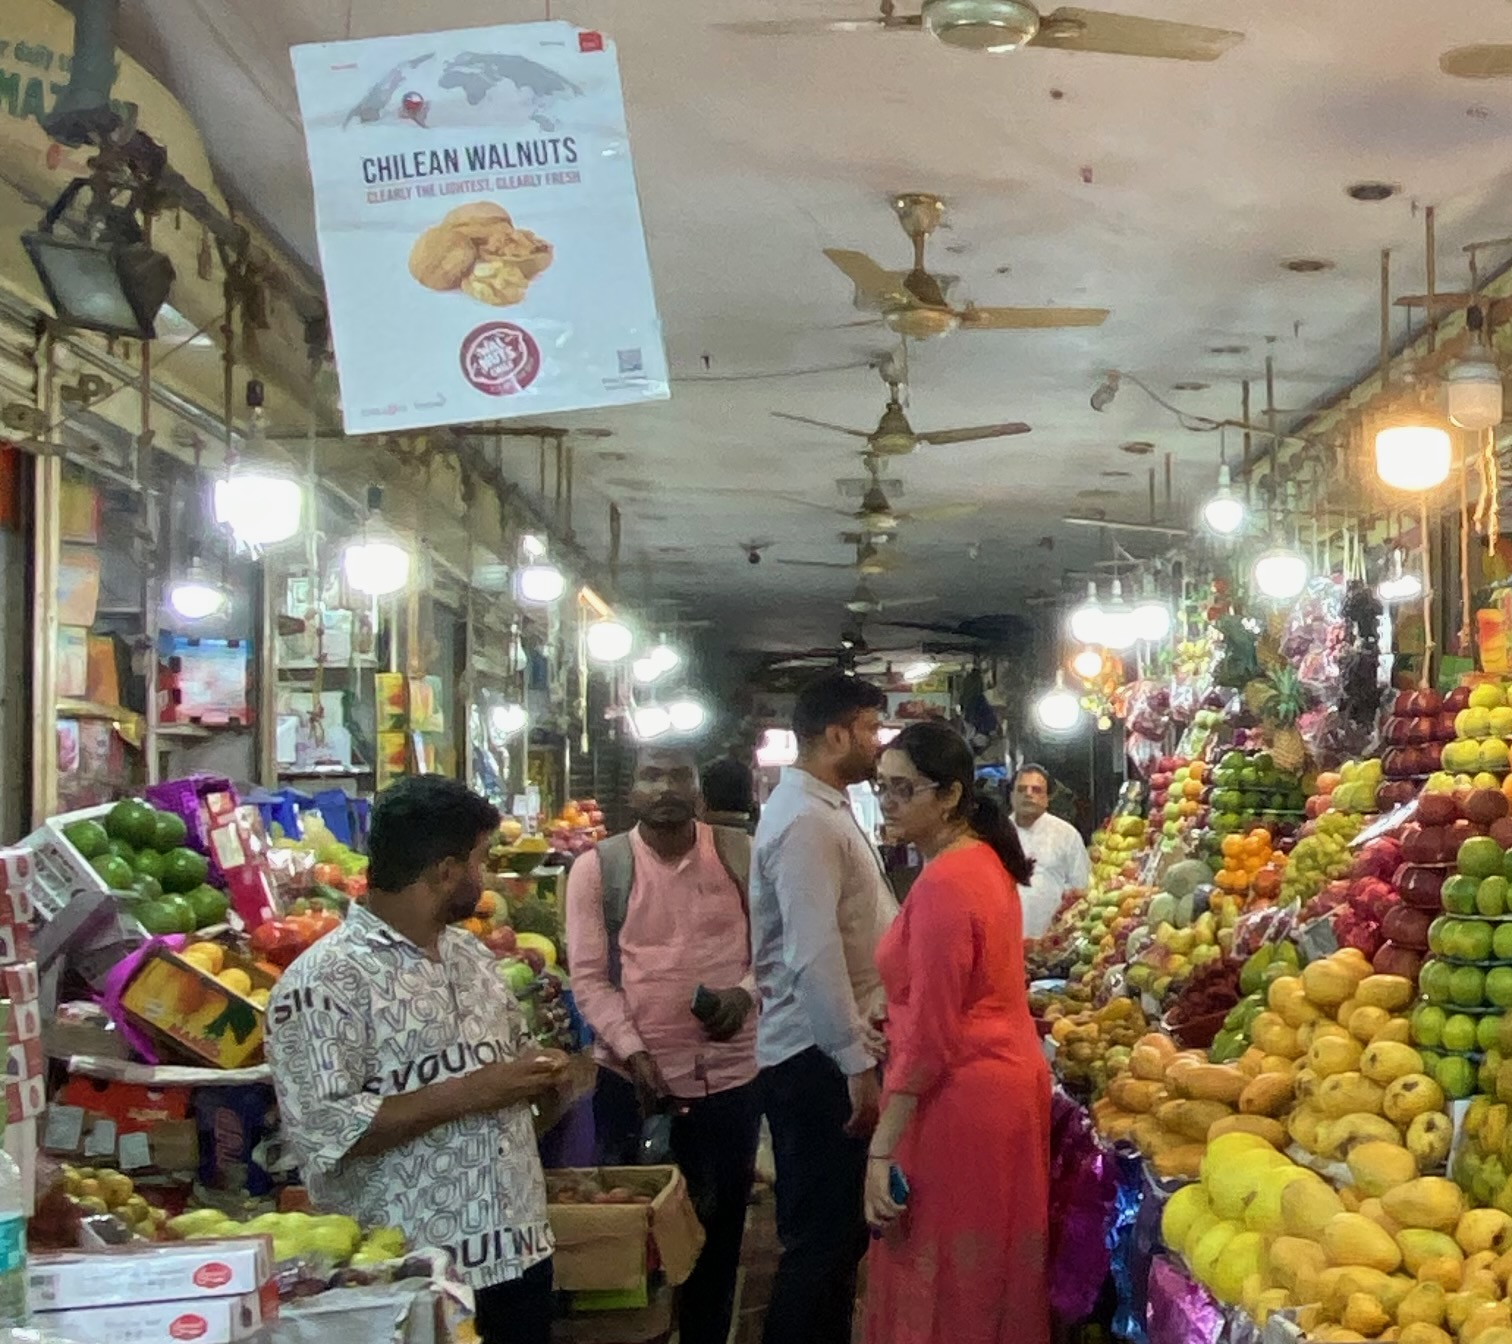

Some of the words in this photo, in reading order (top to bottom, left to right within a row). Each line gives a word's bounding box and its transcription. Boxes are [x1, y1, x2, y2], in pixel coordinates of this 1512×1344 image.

[362, 147, 460, 185] CHILEAN
[465, 137, 578, 172] WALNUTS
[415, 182, 437, 198] THE
